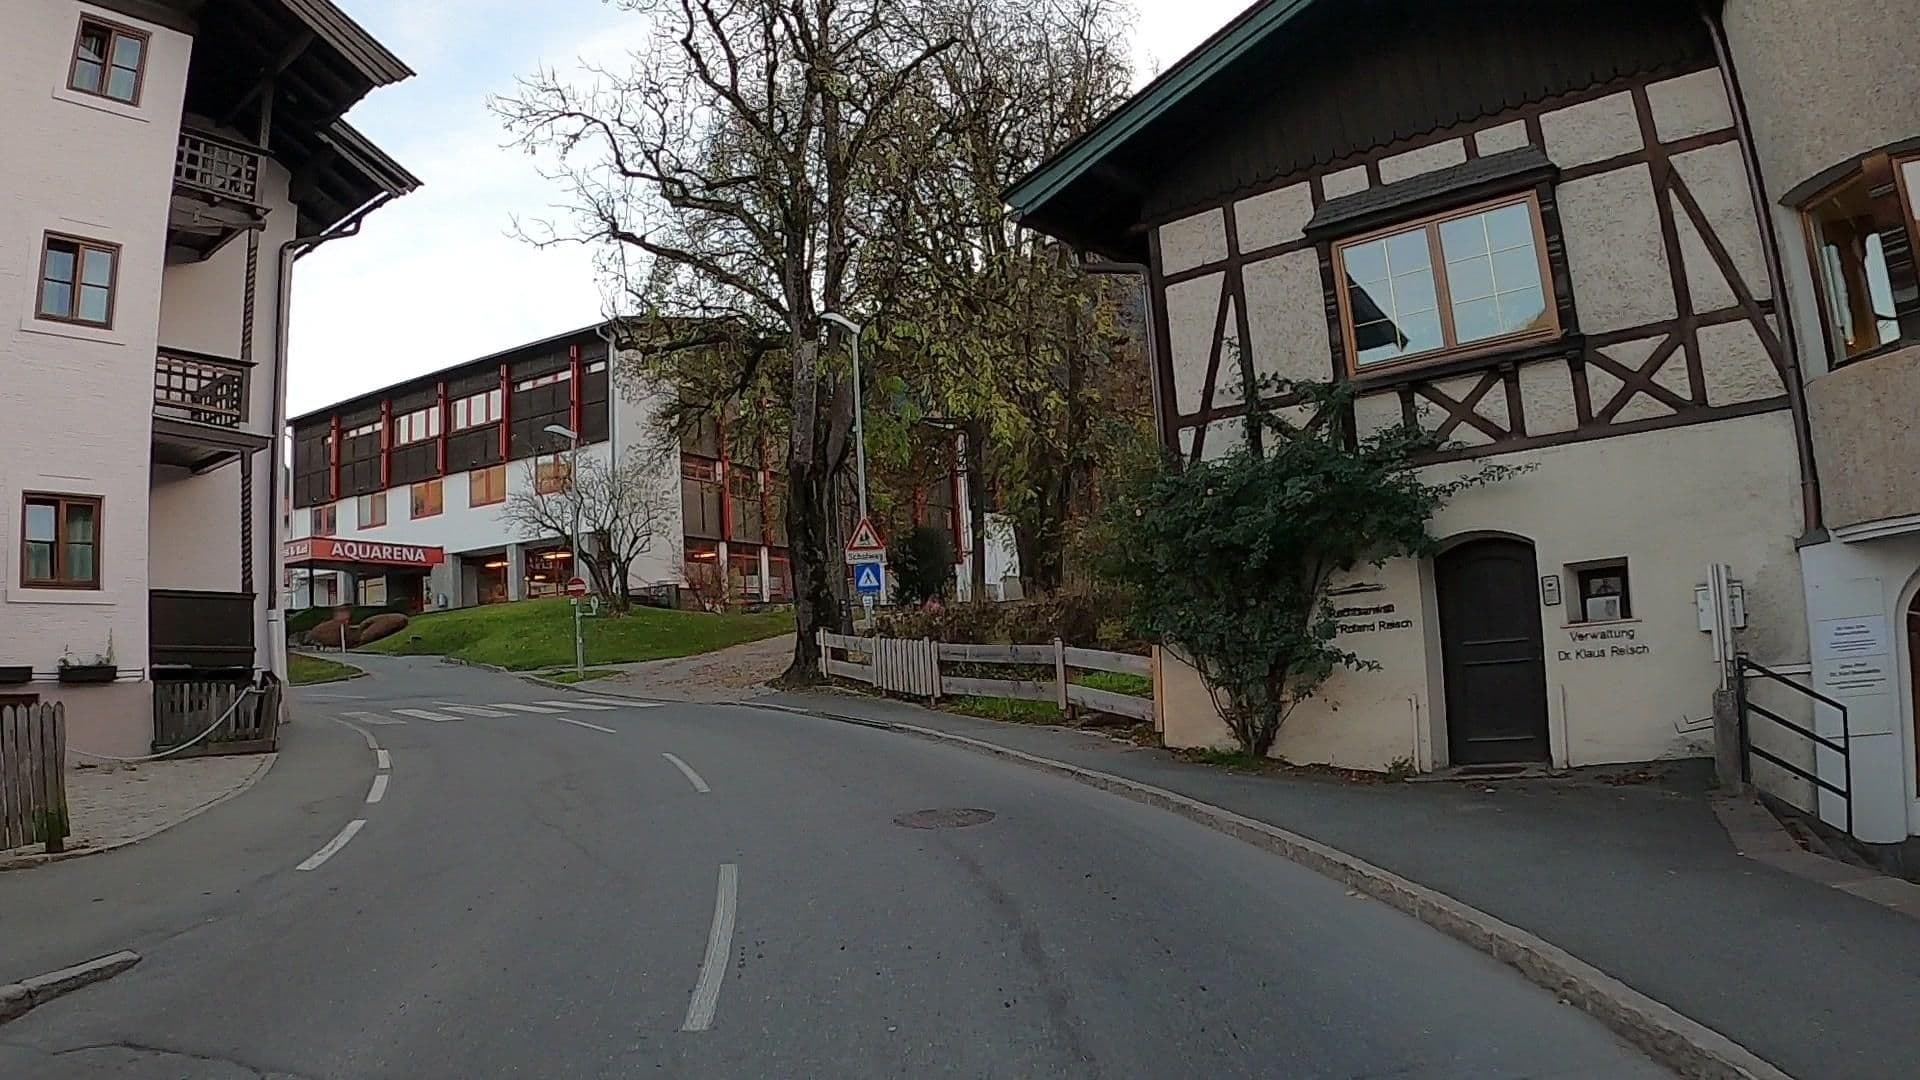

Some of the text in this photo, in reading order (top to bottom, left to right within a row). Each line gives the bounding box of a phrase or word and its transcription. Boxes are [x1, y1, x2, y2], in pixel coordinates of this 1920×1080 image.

[331, 542, 426, 562] AQUARENA
[1340, 622, 1375, 633] Roland
[1379, 620, 1413, 631] Reisch
[1570, 628, 1635, 642] Verwaltung
[1576, 648, 1605, 659] Klaus
[1611, 645, 1650, 656] Reisch
